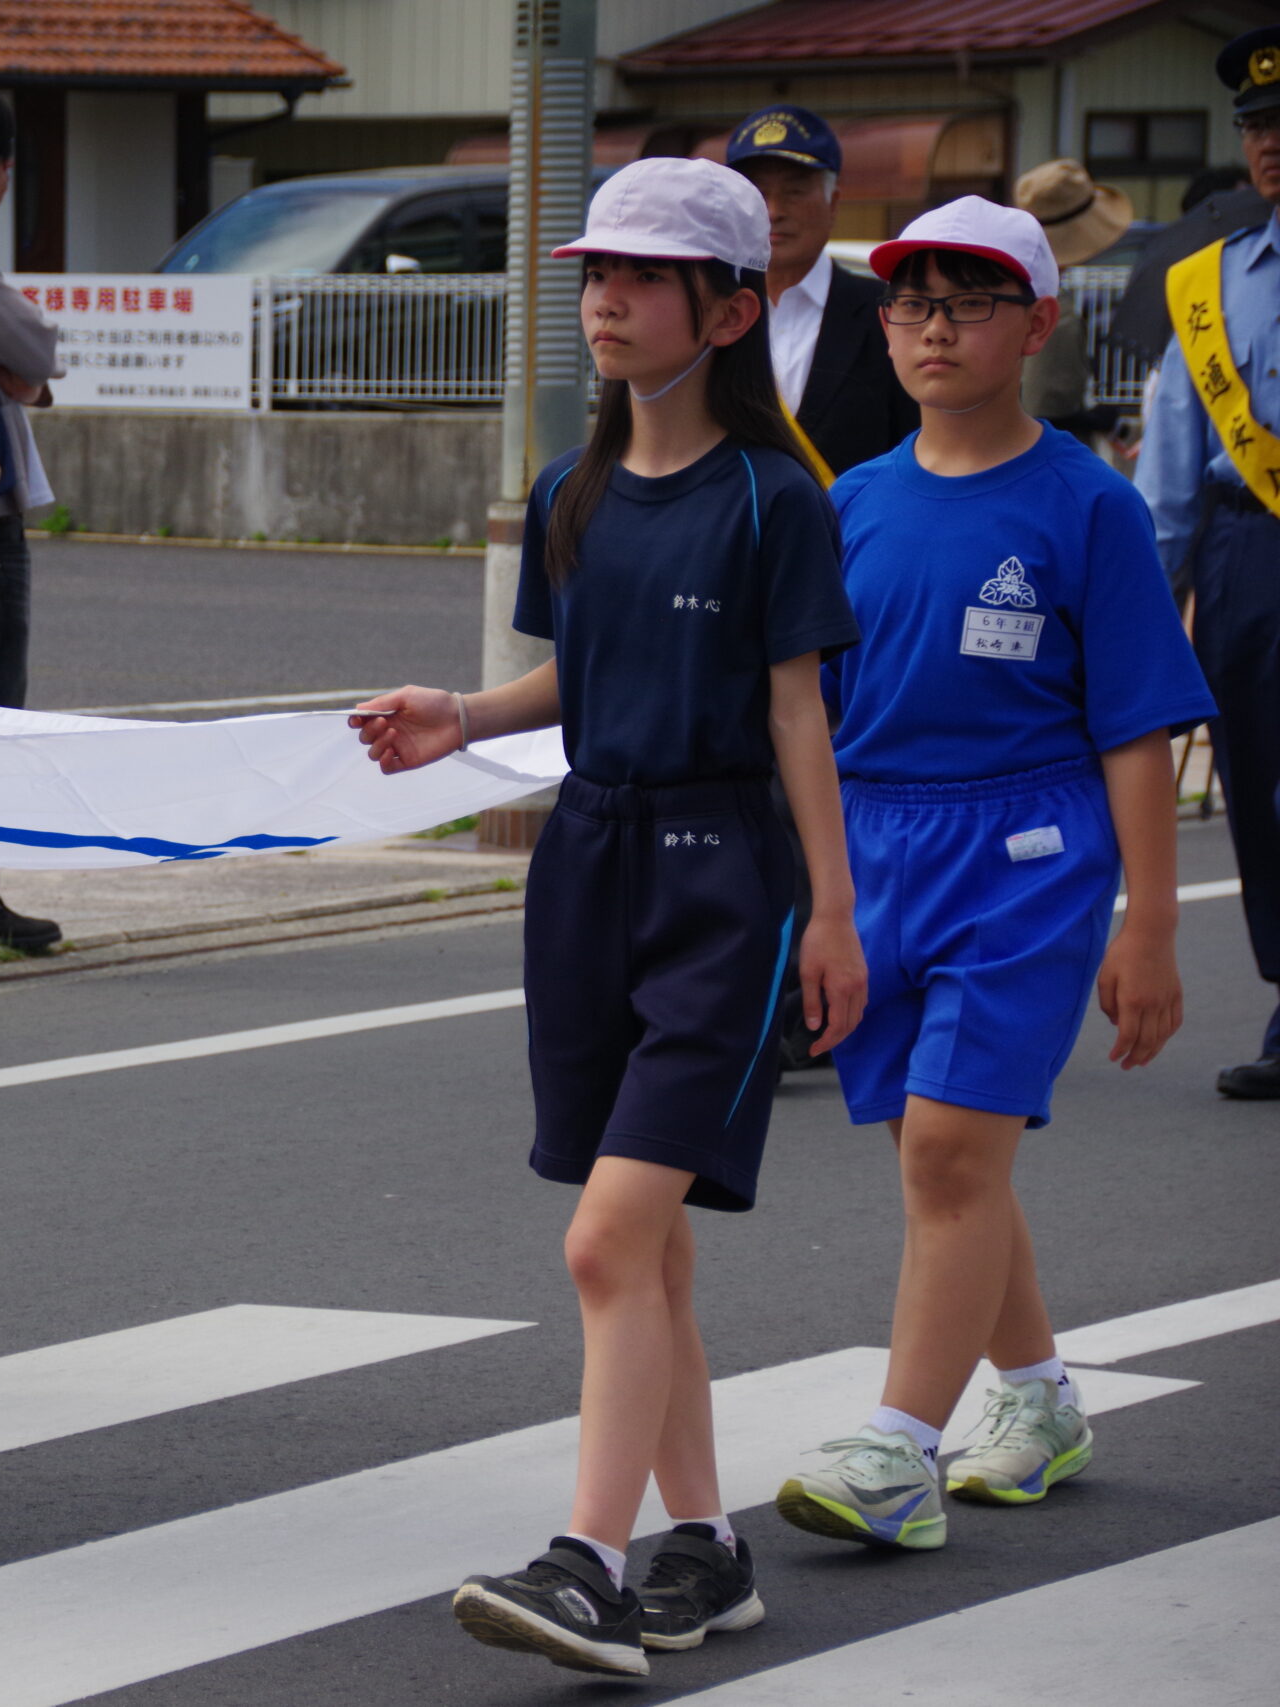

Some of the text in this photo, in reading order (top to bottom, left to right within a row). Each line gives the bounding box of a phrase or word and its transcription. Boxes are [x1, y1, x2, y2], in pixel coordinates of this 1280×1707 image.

[673, 594, 721, 613] 鈴木 心
[664, 831, 721, 847] 鈴木 心
